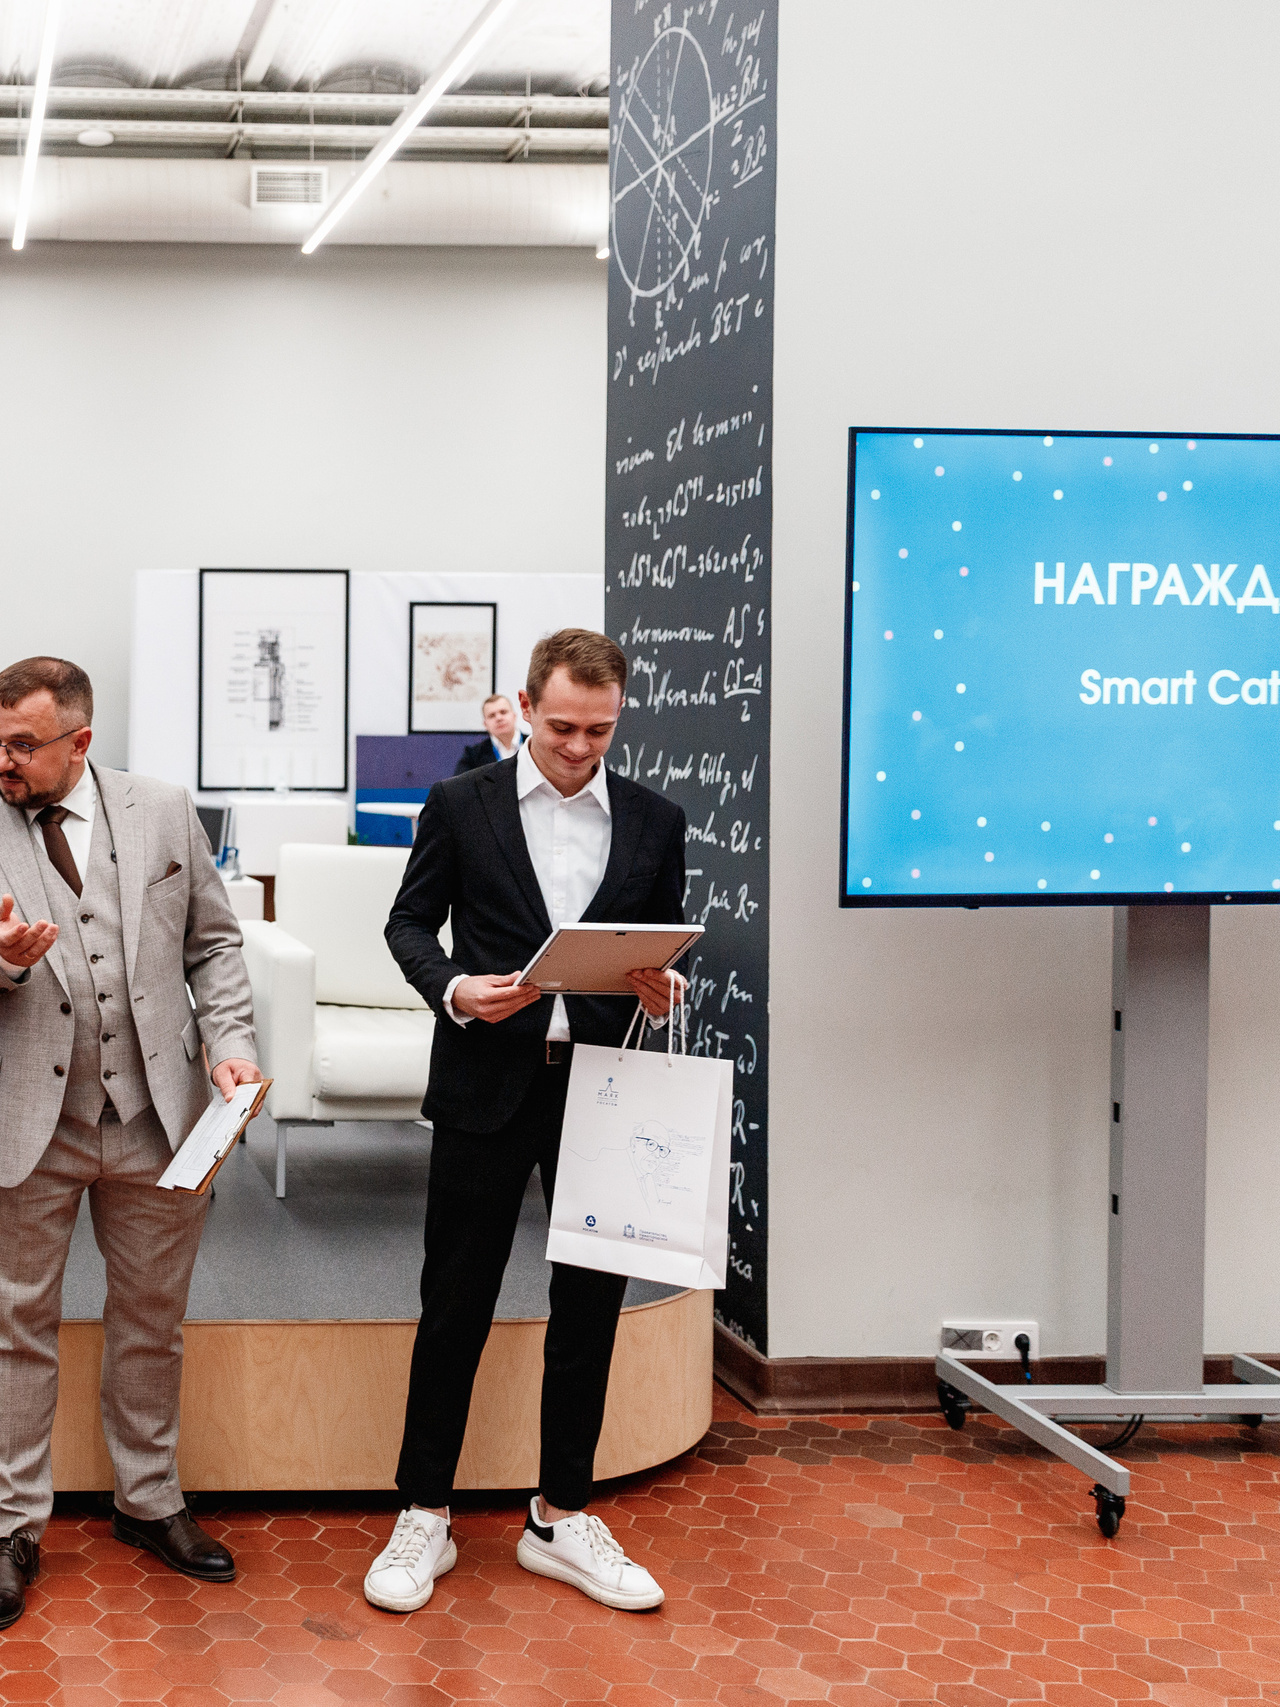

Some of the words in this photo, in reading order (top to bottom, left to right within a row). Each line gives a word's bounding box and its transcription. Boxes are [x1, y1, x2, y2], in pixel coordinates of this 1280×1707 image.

[1034, 562, 1280, 614] НАГРАЖД
[1079, 668, 1196, 706] Smart
[1207, 669, 1280, 706] Cat
